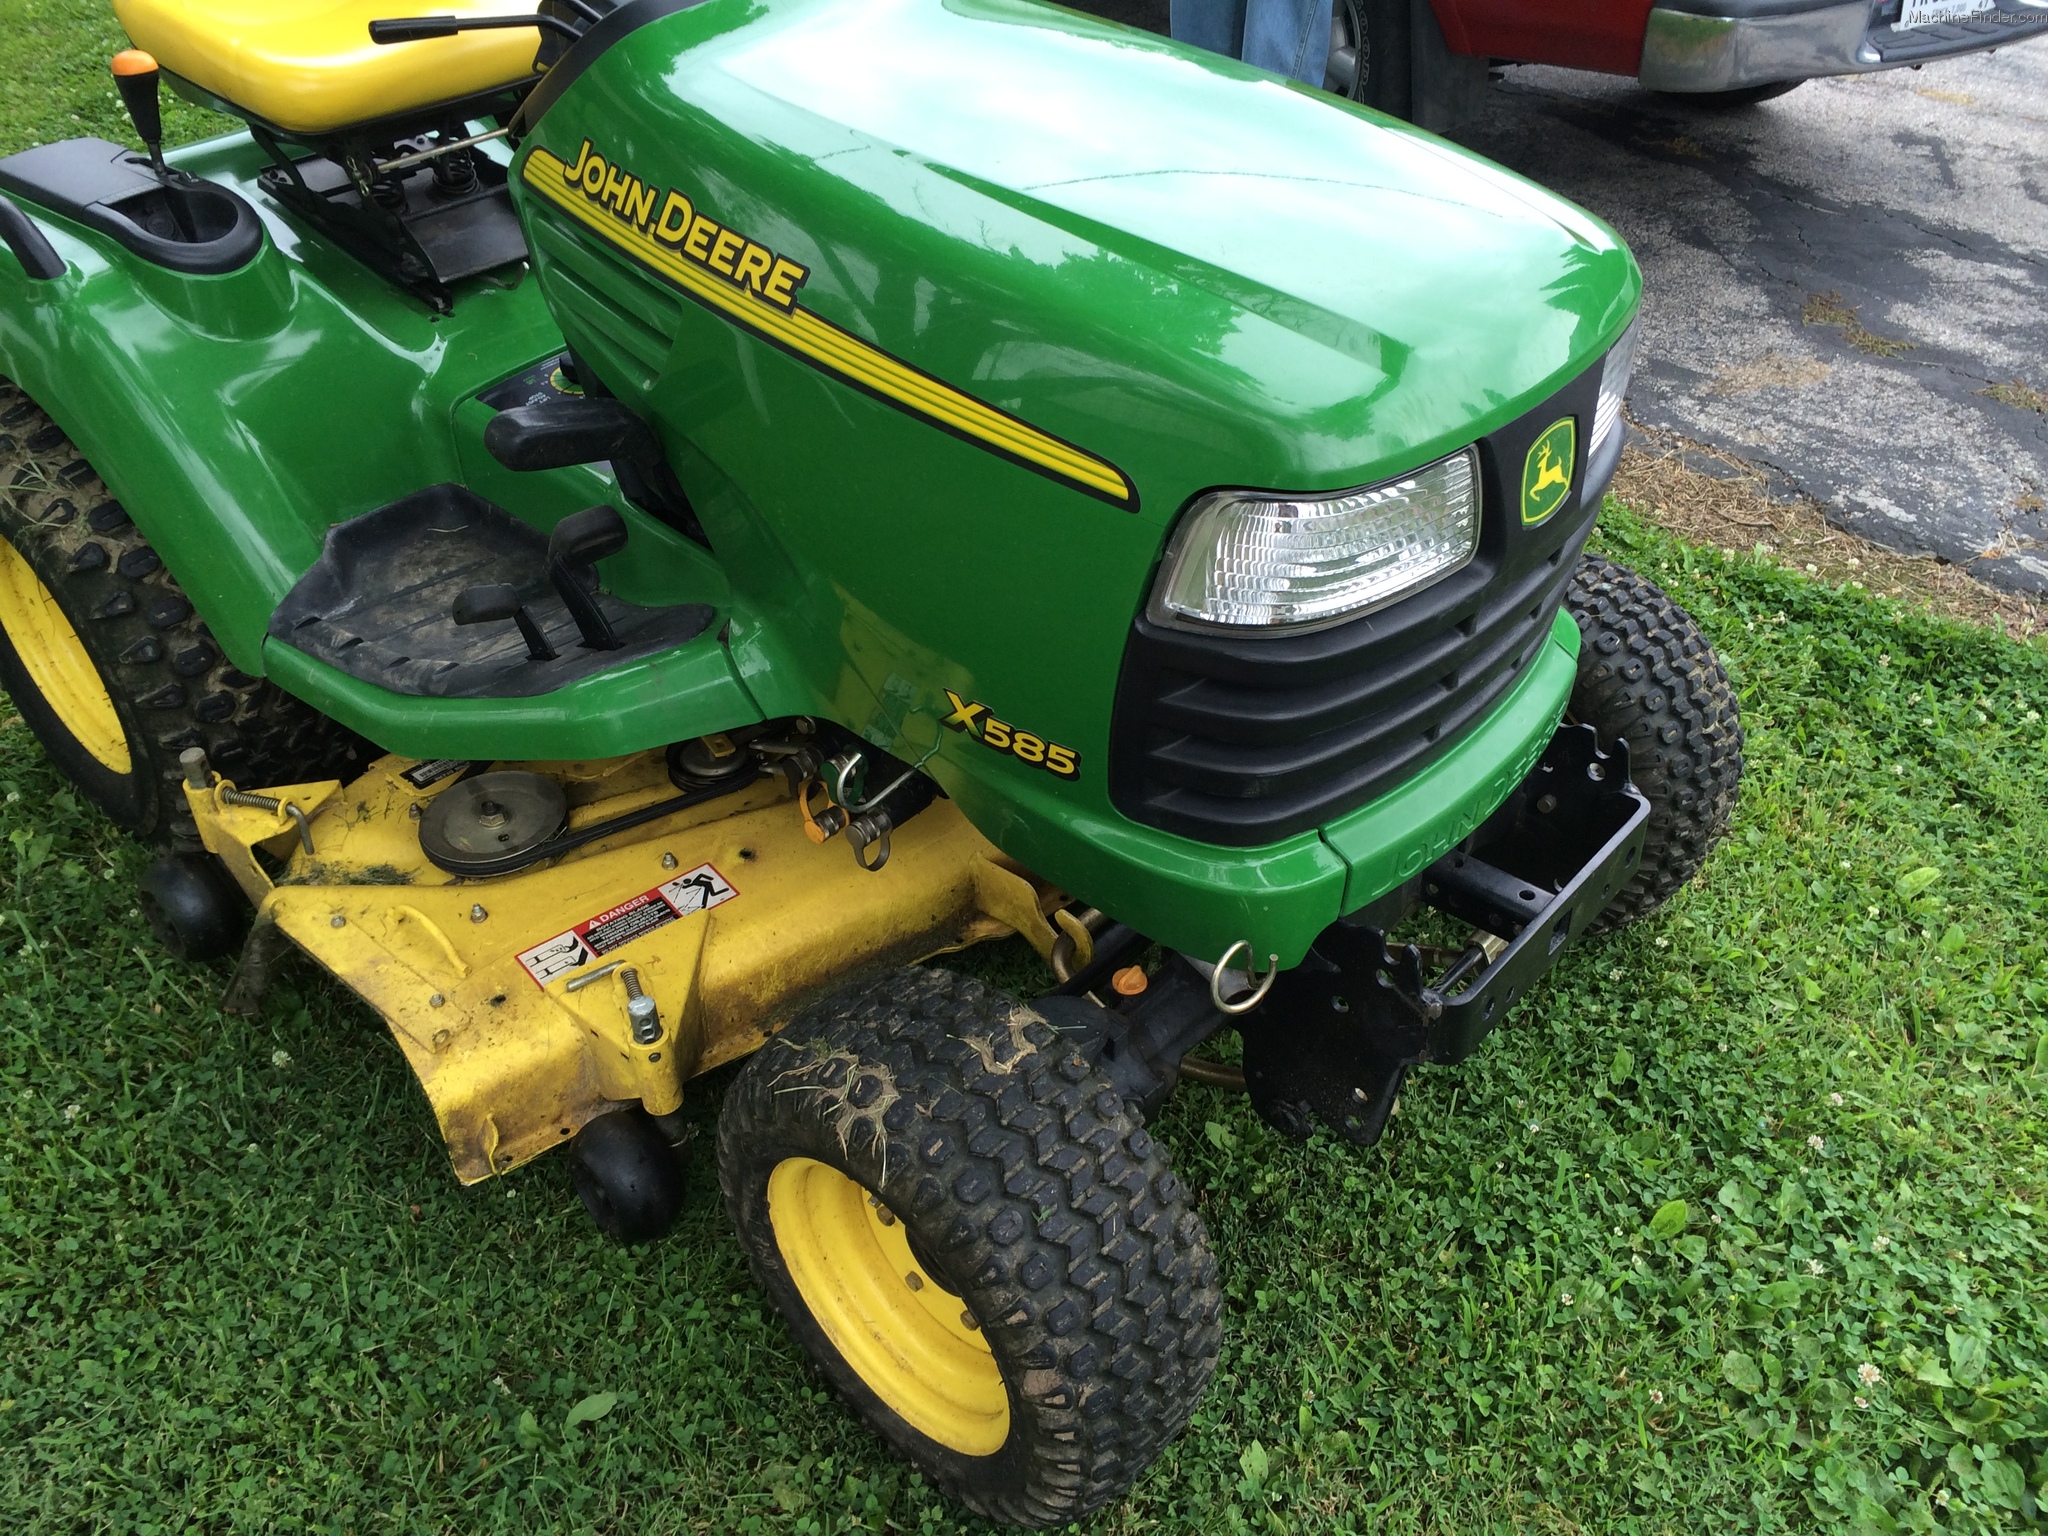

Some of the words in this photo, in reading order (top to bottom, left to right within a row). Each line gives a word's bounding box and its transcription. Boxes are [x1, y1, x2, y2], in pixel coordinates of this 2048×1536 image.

[564, 139, 657, 226] JOHN
[655, 190, 805, 307] DEERE
[942, 689, 1077, 775] X585
[600, 894, 650, 924] DANGER
